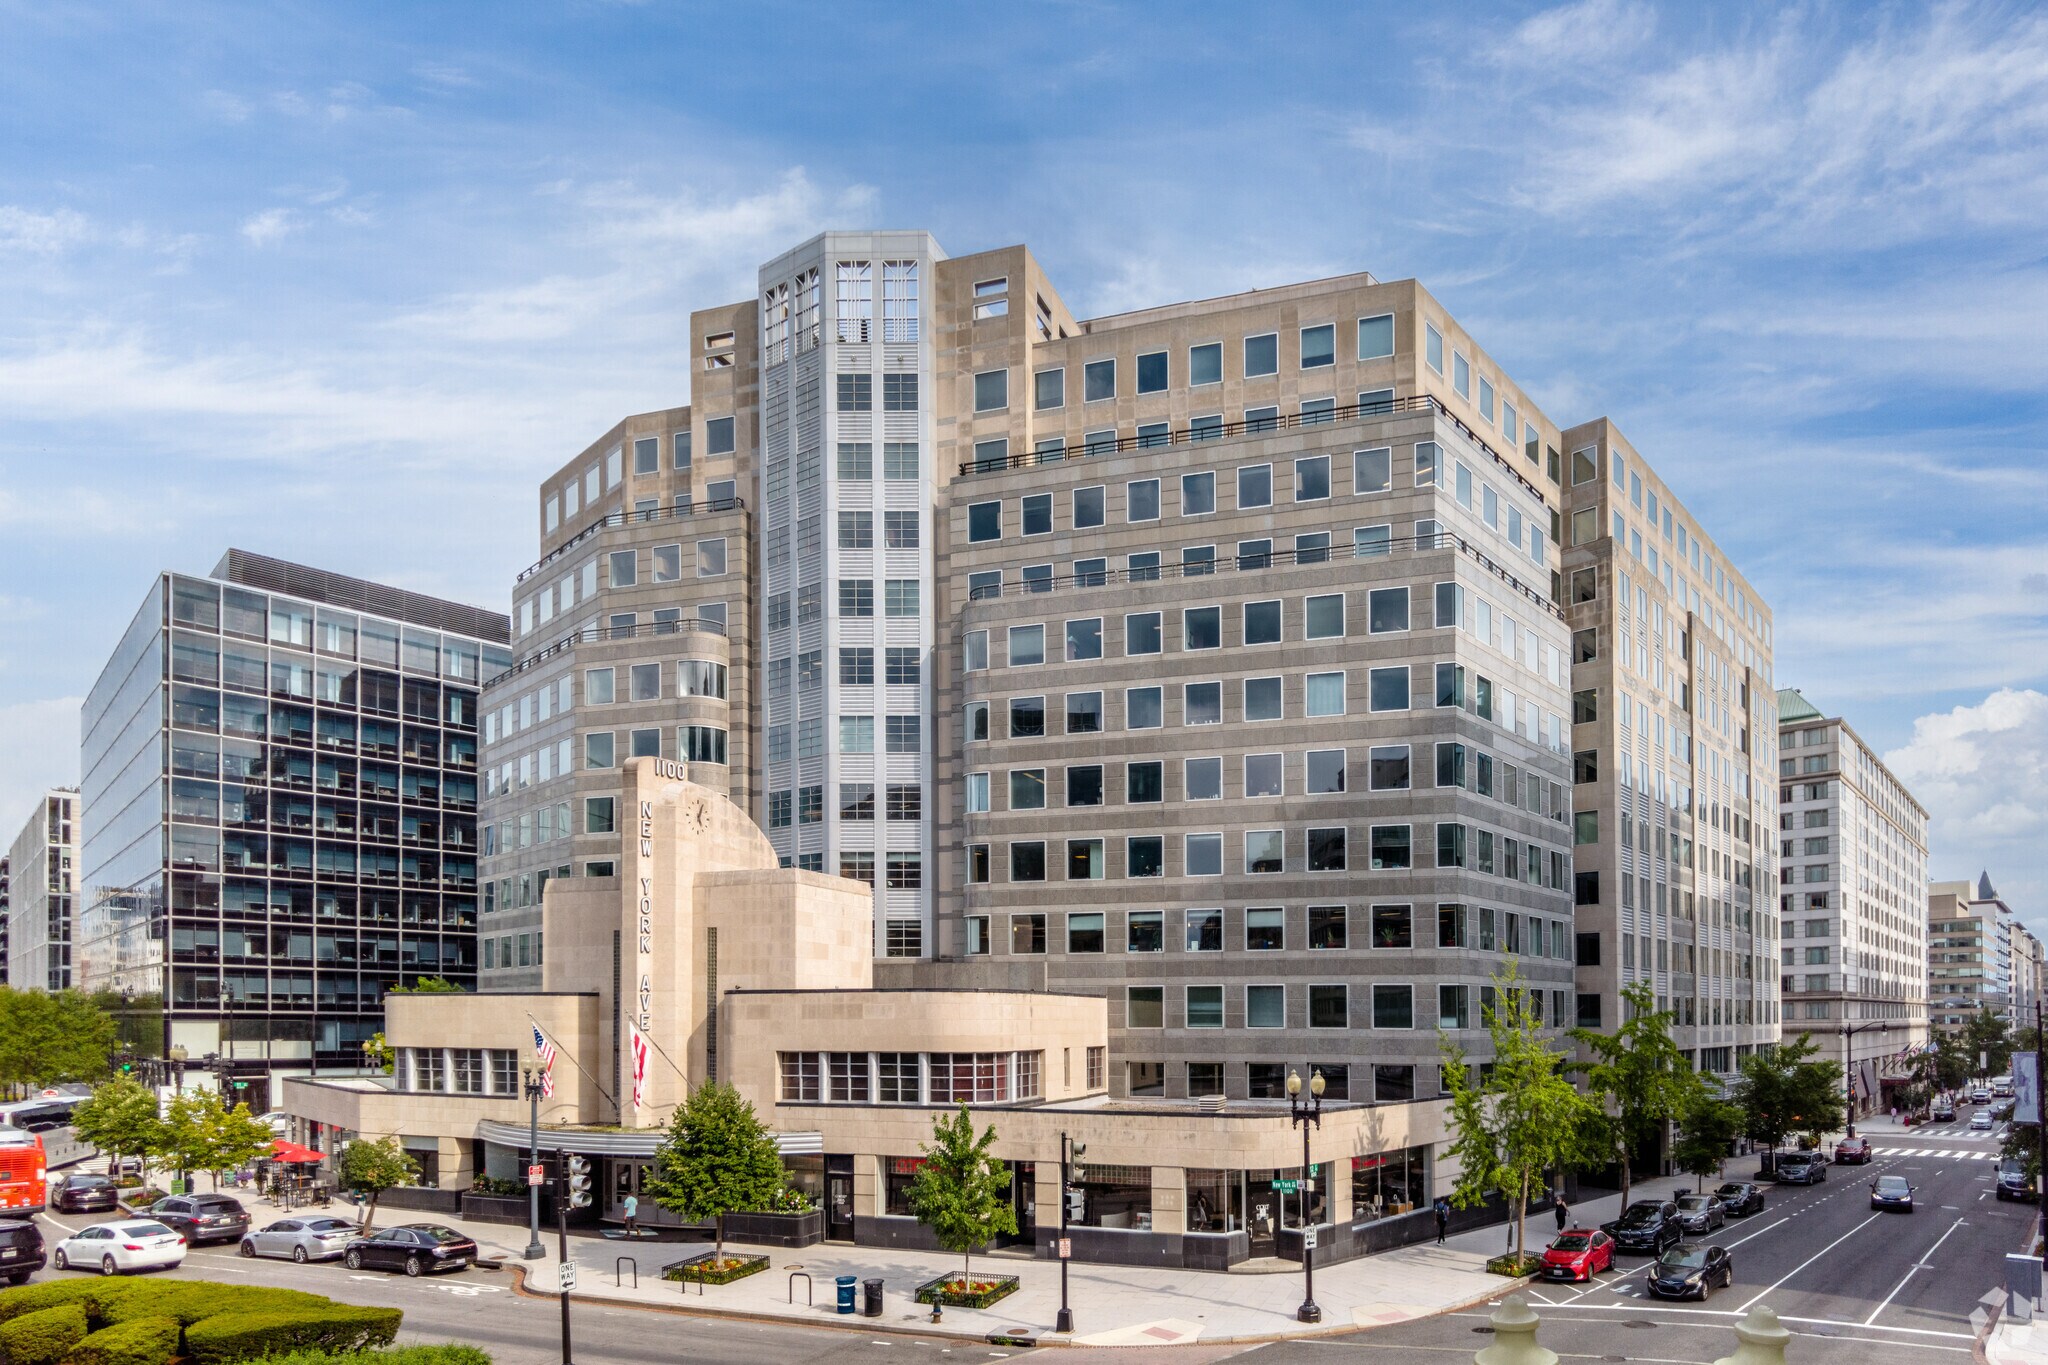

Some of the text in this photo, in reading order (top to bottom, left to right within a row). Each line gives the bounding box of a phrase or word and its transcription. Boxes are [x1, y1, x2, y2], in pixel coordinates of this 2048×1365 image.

[655, 758, 685, 780] 1100
[640, 801, 652, 1032] NEW YORK AVE
[561, 1263, 573, 1272] ONE
[561, 1271, 574, 1280] WAY
